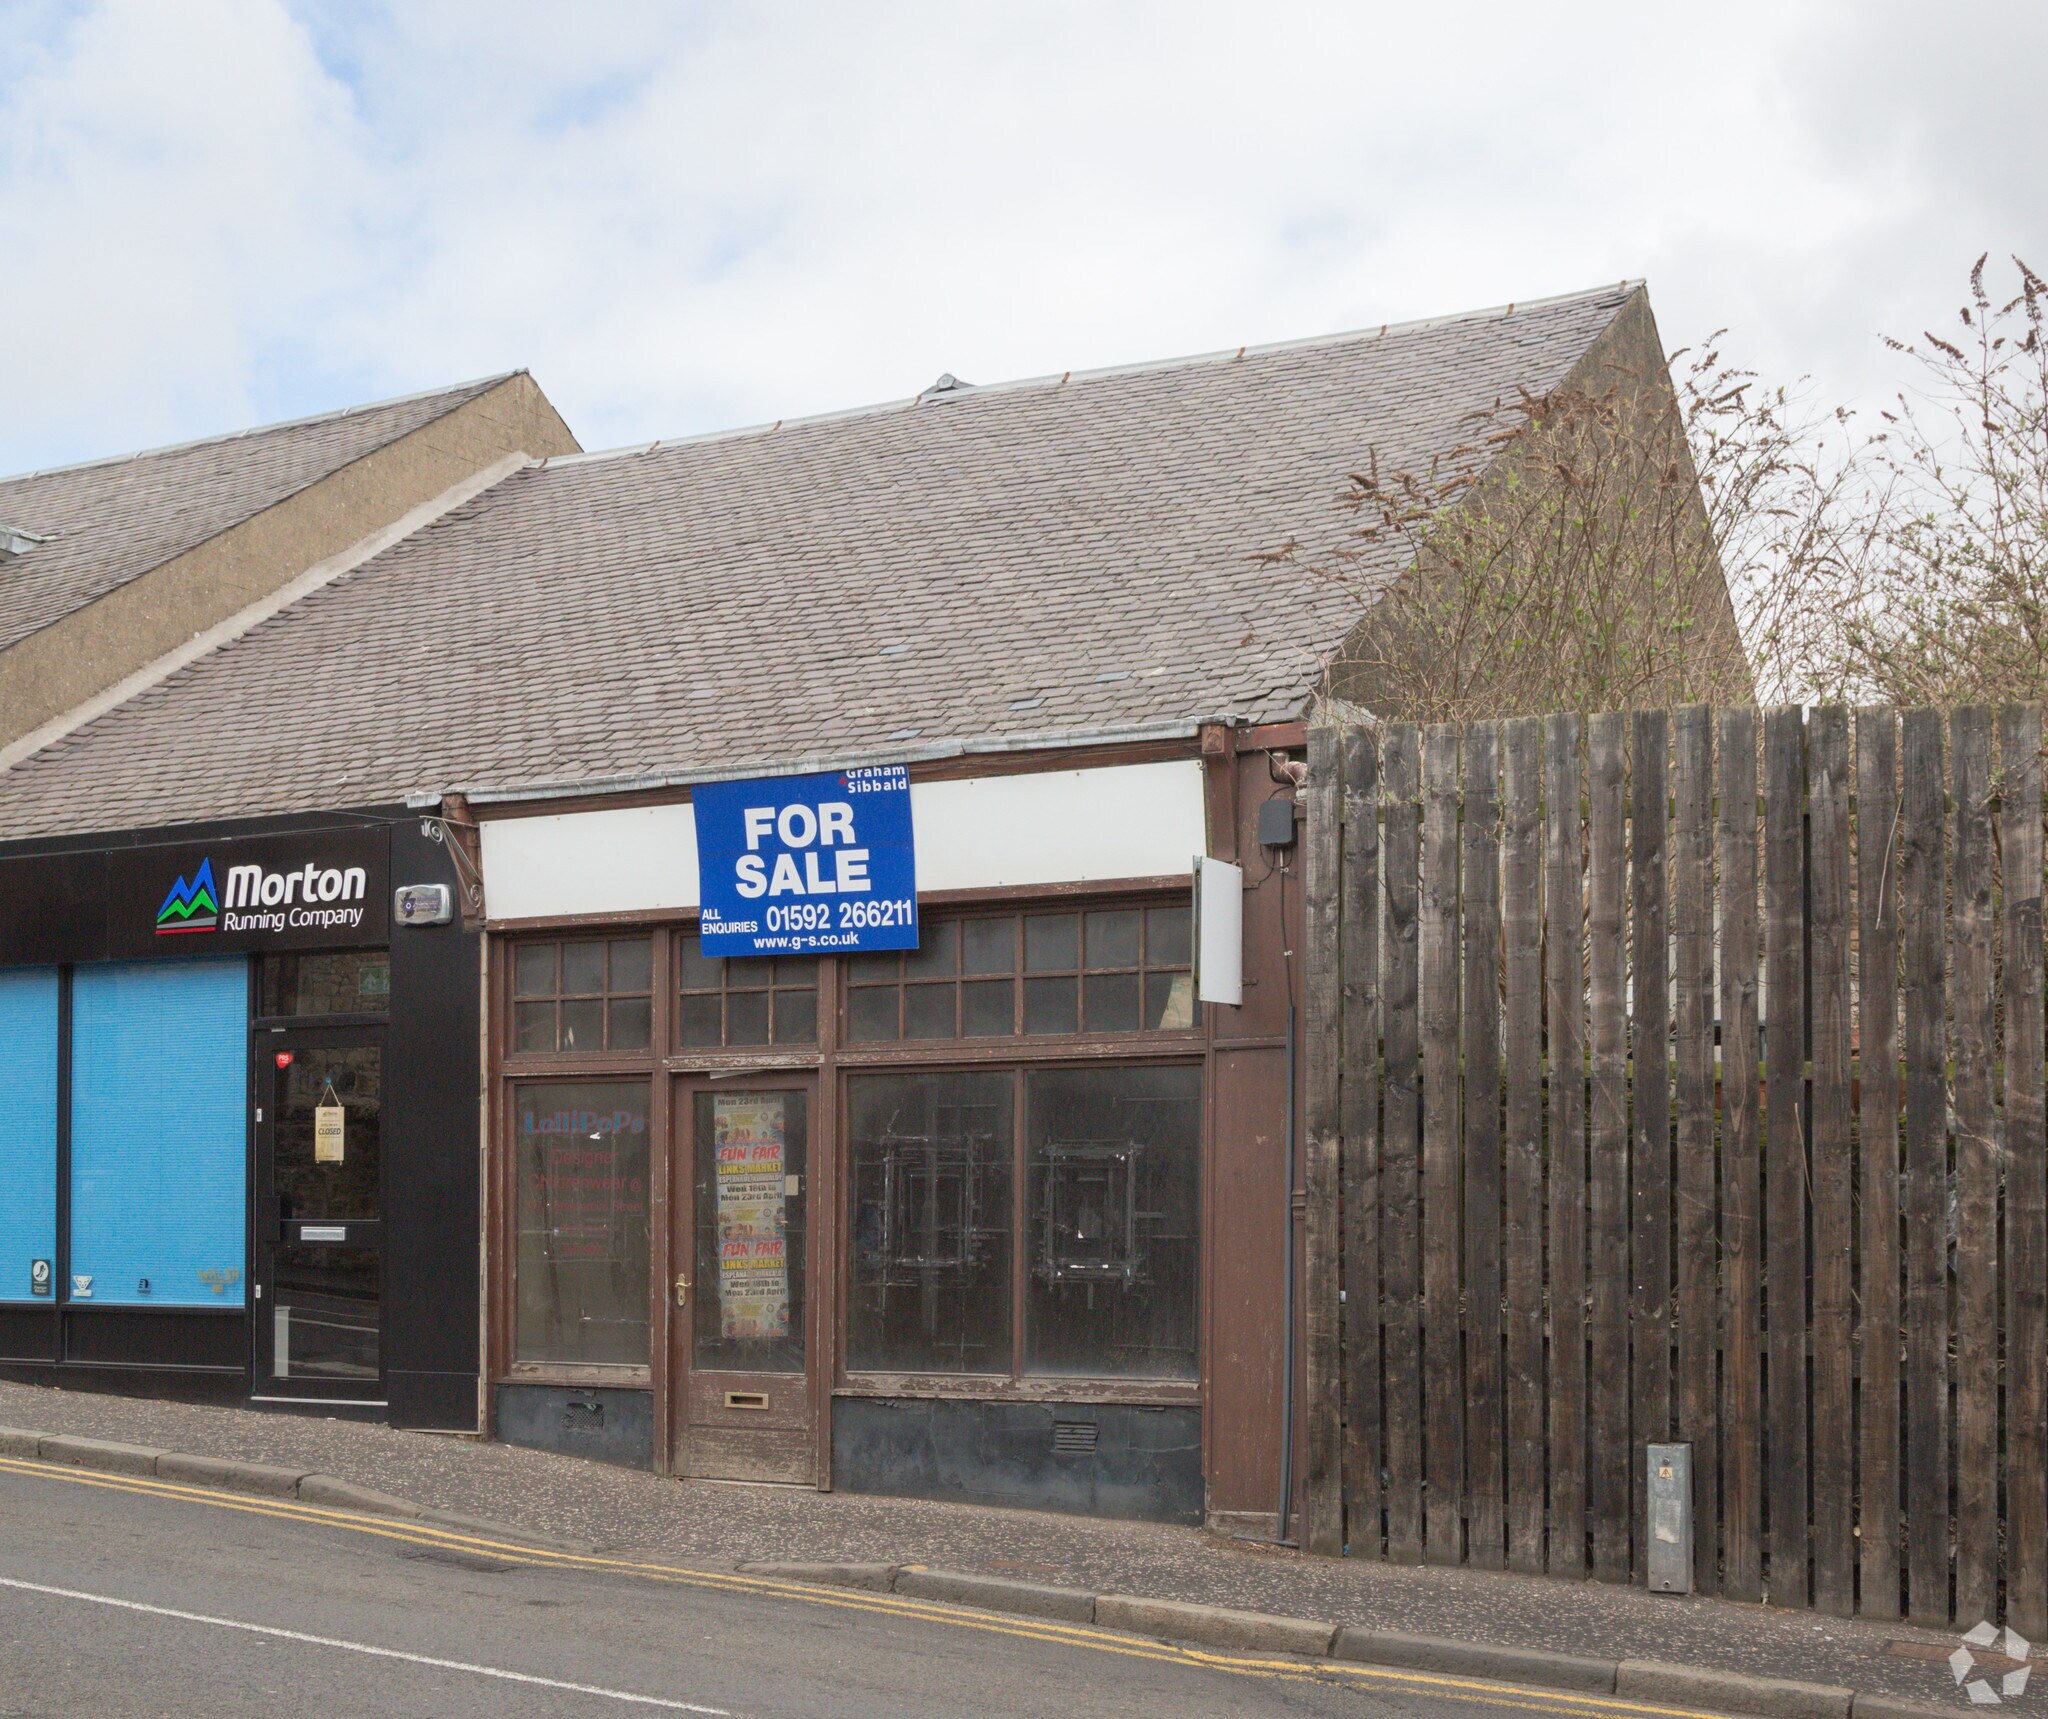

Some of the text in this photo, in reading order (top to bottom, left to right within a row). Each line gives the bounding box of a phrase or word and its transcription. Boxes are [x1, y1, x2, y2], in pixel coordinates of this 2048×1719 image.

[846, 766, 906, 779] Graham
[847, 778, 907, 794] Sibbald
[743, 801, 856, 850] FOR
[735, 848, 872, 898] SALE
[224, 862, 367, 909] Morton
[223, 906, 364, 933] Running Company
[702, 908, 721, 921] ALL
[766, 899, 913, 932] 01592 266211
[702, 920, 759, 935] ENQUIRIES
[753, 931, 860, 950] www.g-s.co.uk
[318, 1127, 342, 1136] CLOSED
[550, 1148, 620, 1168] Designer
[721, 1145, 781, 1161] FUN FAIR
[719, 1162, 783, 1176] LINKS MARKET
[630, 1178, 642, 1193] @
[764, 1193, 783, 1201] April
[723, 1240, 783, 1258] FUN FAIR
[722, 1258, 785, 1270] LINKS MARKET
